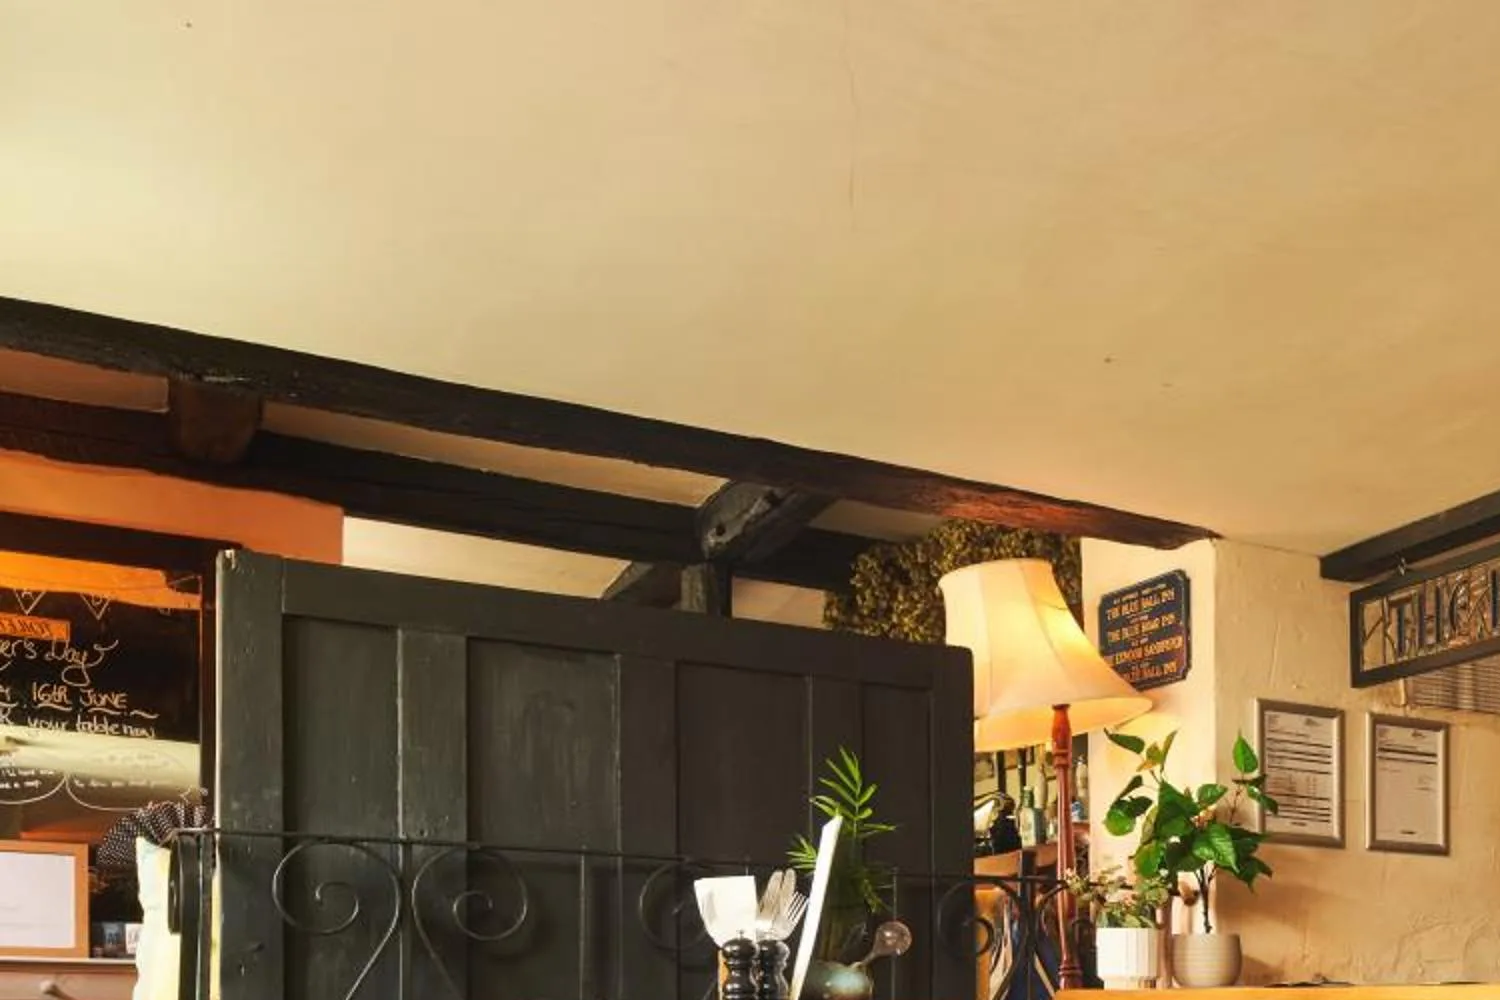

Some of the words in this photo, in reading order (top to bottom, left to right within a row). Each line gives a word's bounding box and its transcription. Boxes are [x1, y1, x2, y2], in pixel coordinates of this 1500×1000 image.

[1388, 574, 1476, 655] THE
[79, 688, 128, 709] JUNE
[75, 713, 120, 735] table
